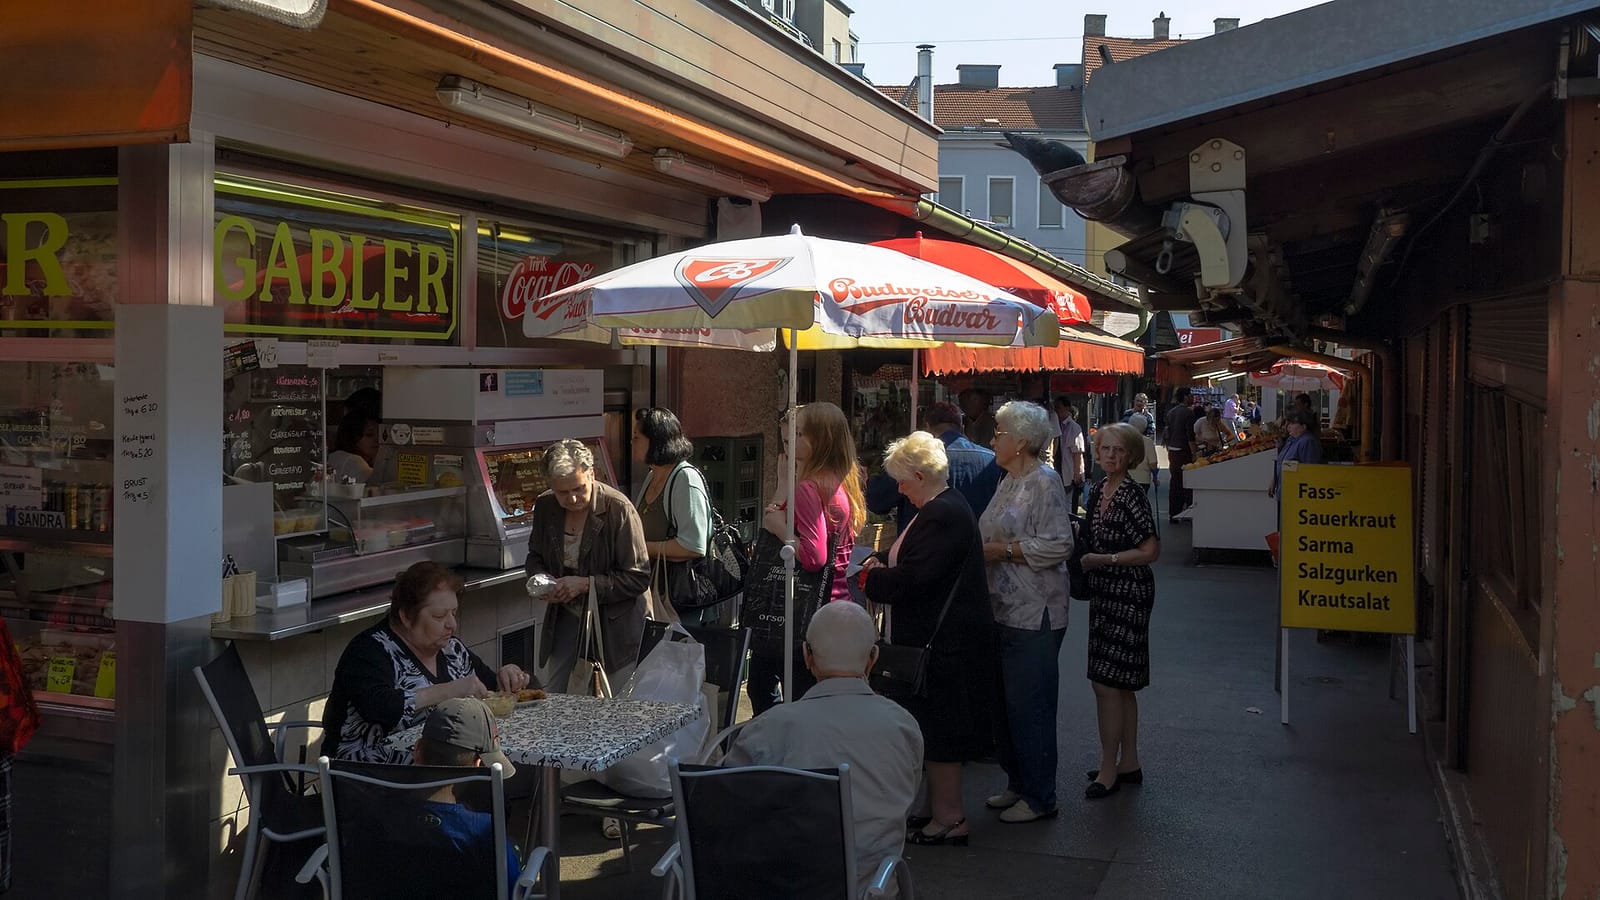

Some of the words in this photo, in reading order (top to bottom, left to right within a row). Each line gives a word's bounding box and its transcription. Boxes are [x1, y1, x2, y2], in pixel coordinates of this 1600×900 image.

[214, 215, 449, 314] GABLER
[528, 256, 550, 272] Trink
[828, 277, 993, 303] Budweiser
[904, 296, 1001, 330] Budvar
[1177, 332, 1193, 344] ei
[400, 455, 425, 463] CAUTION
[124, 477, 149, 489] BRUST
[1299, 483, 1341, 499] Fass-
[18, 511, 63, 528] SANDRA
[1299, 509, 1396, 528] Sauerkraut
[1299, 536, 1353, 553] Sarma
[1299, 563, 1397, 584] Salzgurken
[1299, 590, 1390, 610] Krautsalat
[759, 613, 785, 626] orsay
